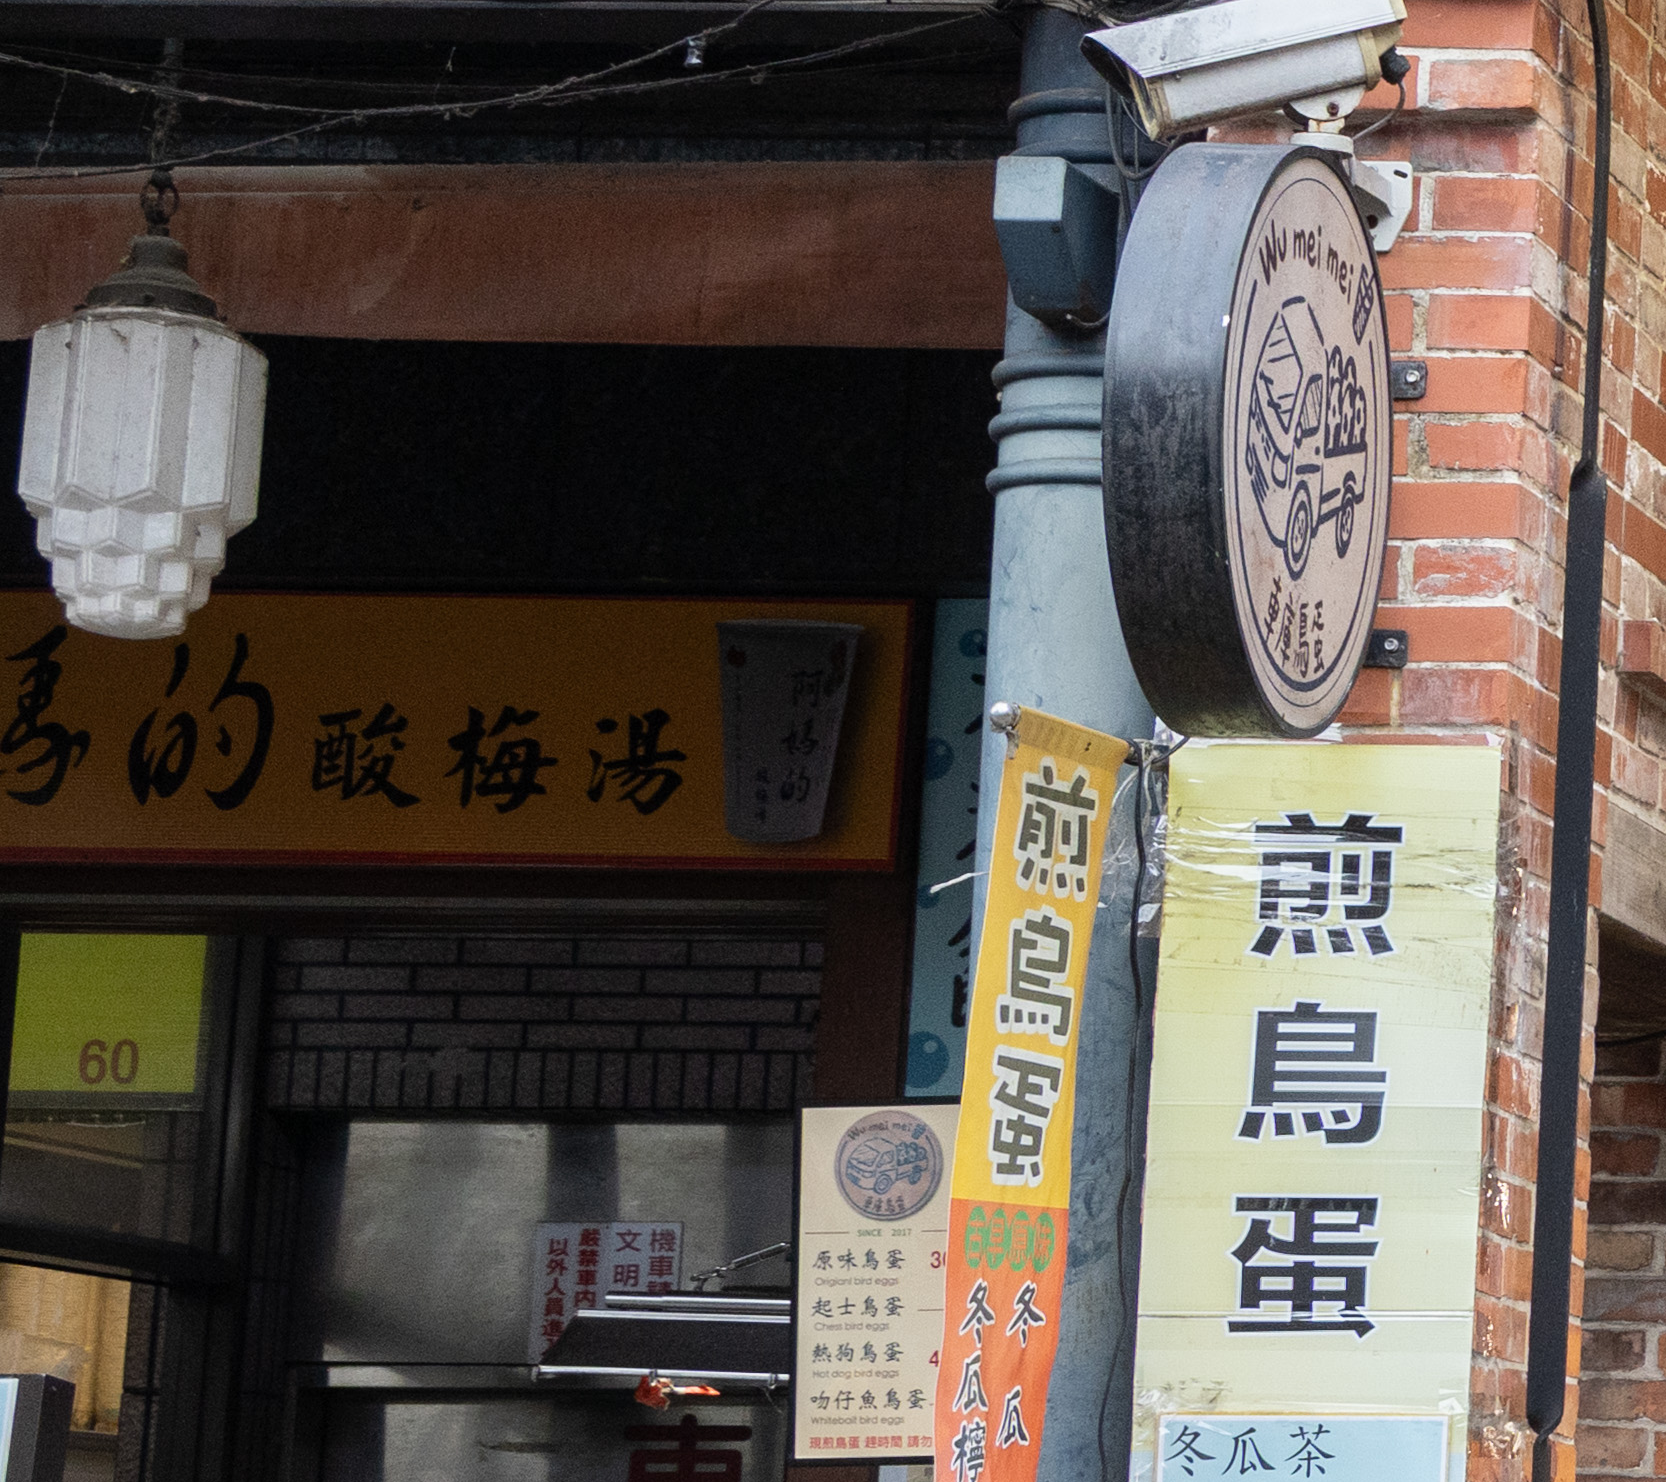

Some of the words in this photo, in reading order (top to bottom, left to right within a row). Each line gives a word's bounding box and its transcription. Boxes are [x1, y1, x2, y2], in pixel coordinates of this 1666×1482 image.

[1257, 218, 1289, 288] Wu
[1292, 224, 1322, 270] mei
[1324, 247, 1355, 307] mei
[311, 703, 689, 815] 酸梅湯
[988, 757, 1098, 1187] 煎鳥蛋
[78, 1037, 140, 1085] 60
[1227, 811, 1404, 1341] 煎鳥蛋
[856, 1228, 883, 1238] SINCE
[891, 1228, 913, 1237] 2017
[853, 1276, 873, 1287] bird
[874, 1278, 900, 1288] eggs
[844, 1321, 864, 1331] bird
[865, 1323, 890, 1332] eggs
[812, 1369, 830, 1379] Hot
[831, 1368, 852, 1380] dog
[853, 1368, 873, 1379] bird
[874, 1369, 900, 1379] eggs
[859, 1415, 879, 1425] bird
[880, 1416, 906, 1426] eggs
[1164, 1422, 1335, 1478] 冬瓜茶
